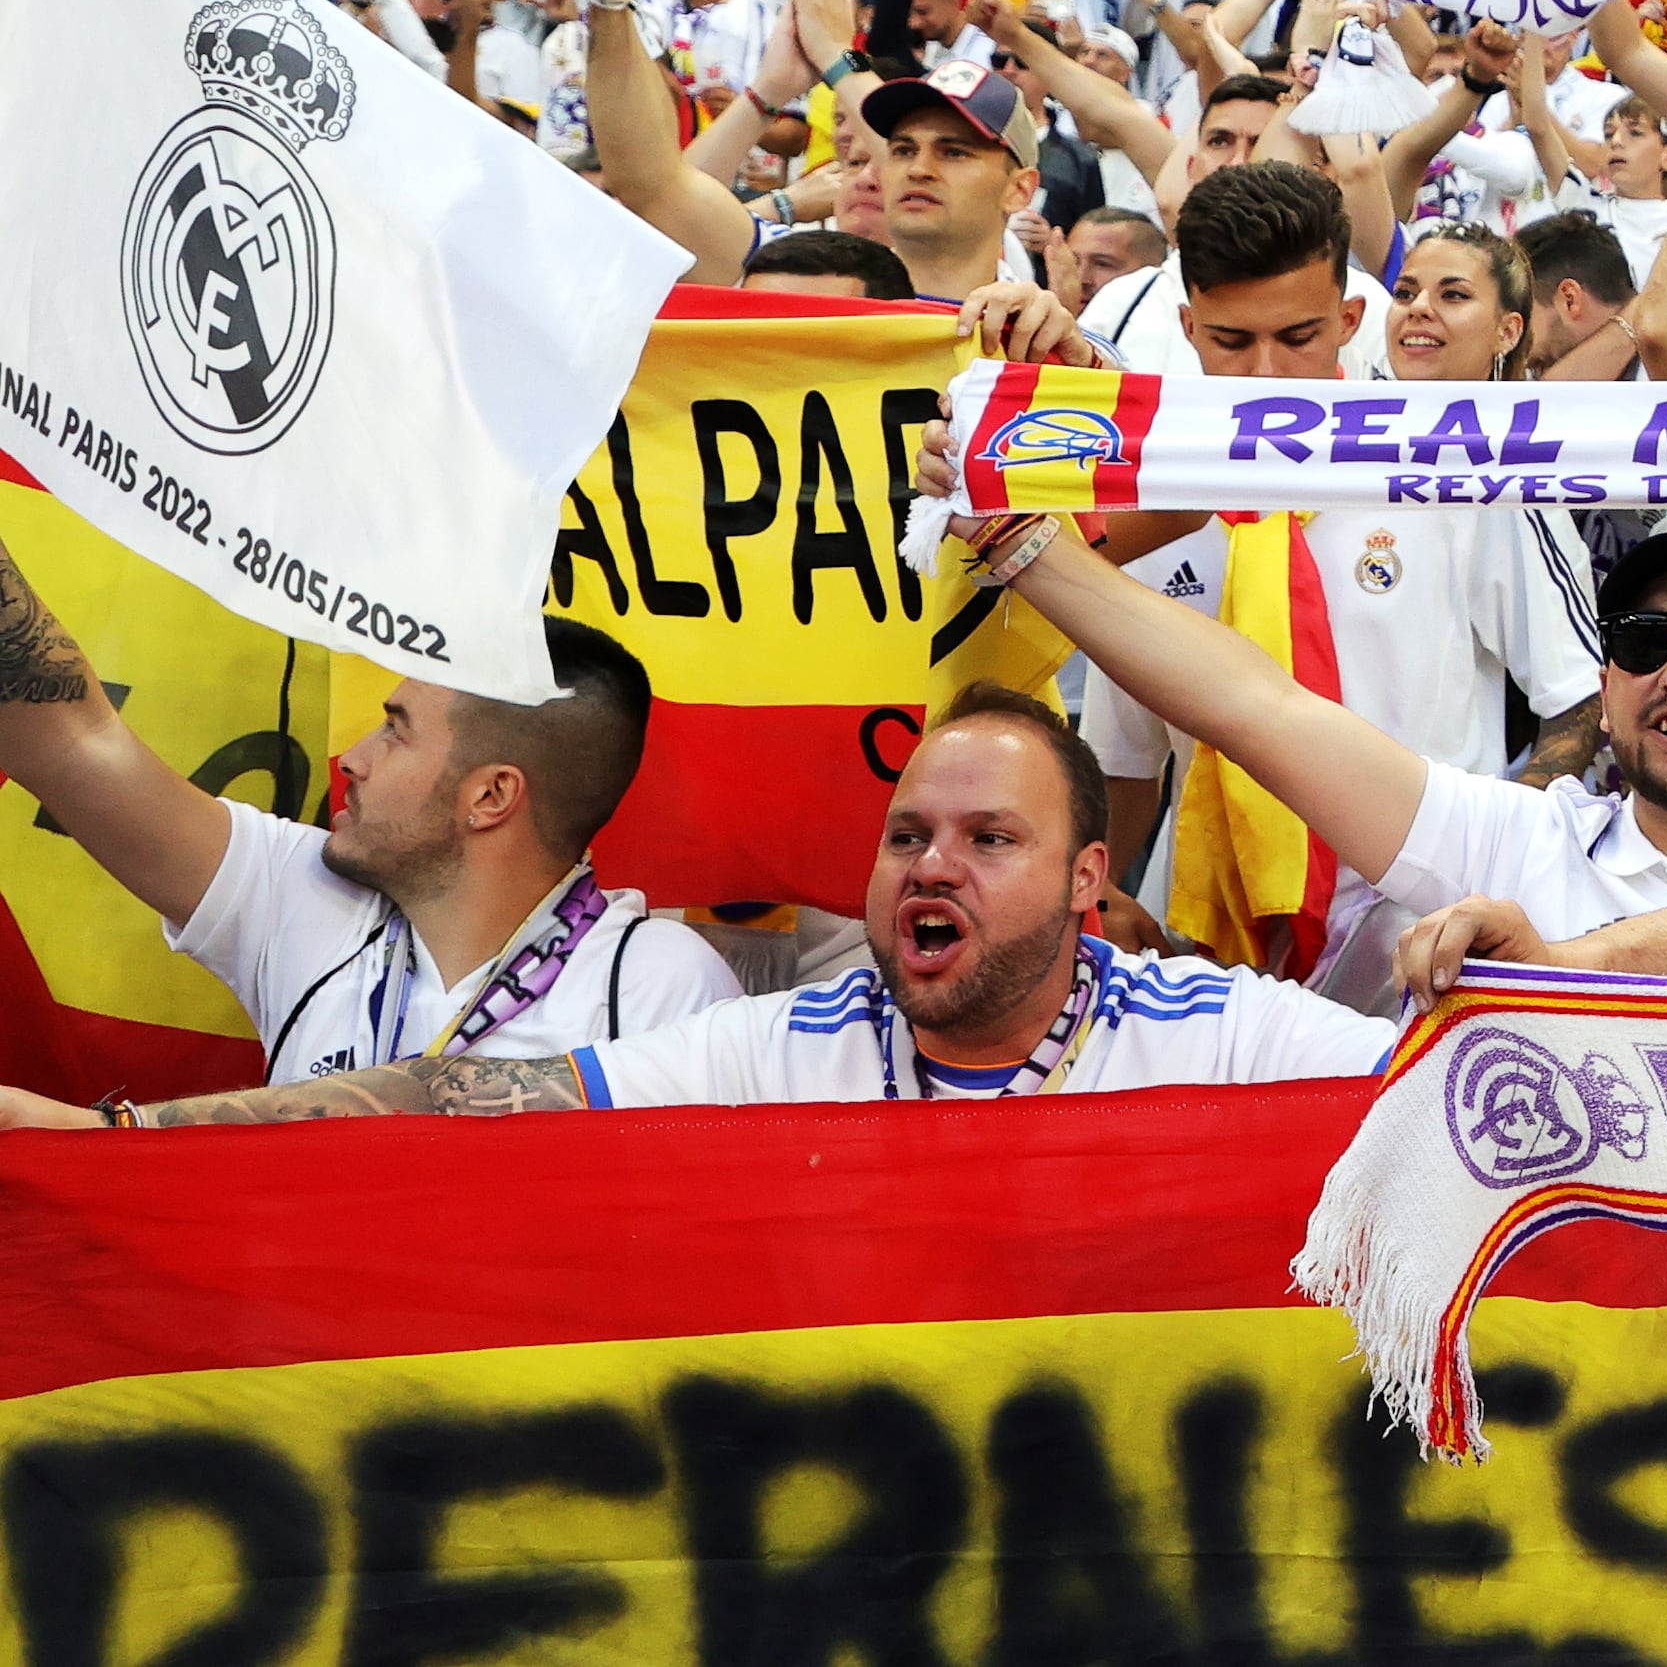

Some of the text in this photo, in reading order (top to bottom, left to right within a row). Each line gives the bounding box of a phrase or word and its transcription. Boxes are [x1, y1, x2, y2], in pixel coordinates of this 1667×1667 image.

[1229, 396, 1565, 467] REAL
[0, 362, 52, 438] NAL
[57, 406, 139, 495] PARIS
[142, 465, 213, 546] 2022
[232, 525, 452, 664] 28/05/2022
[1383, 473, 1609, 505] REYES
